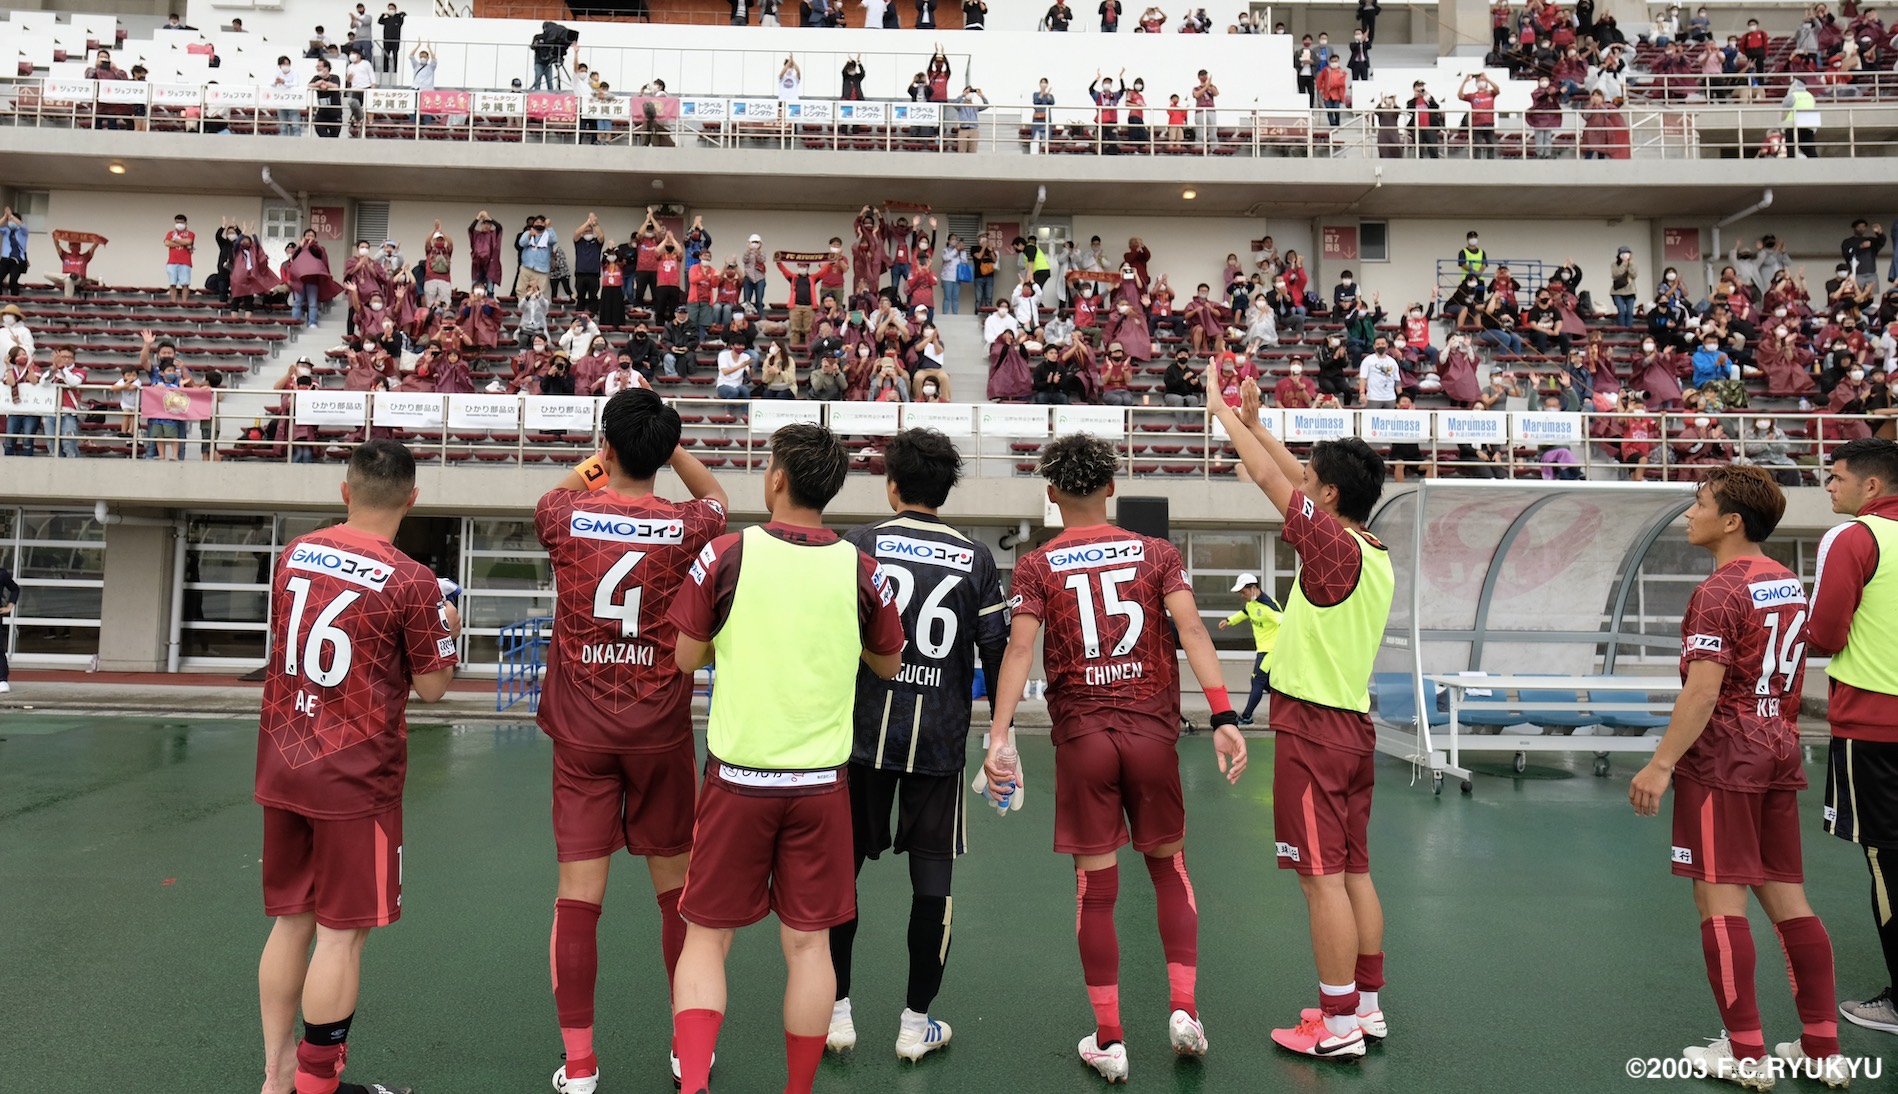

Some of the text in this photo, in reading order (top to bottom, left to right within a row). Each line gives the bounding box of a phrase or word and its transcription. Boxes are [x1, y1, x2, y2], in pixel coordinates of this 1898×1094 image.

[373, 99, 408, 109] 沖縄市
[481, 102, 516, 112] 沖縄市
[588, 105, 623, 114] 沖縄市
[311, 401, 362, 410] ひかり部品店
[390, 403, 440, 412] ひかり部品店
[465, 405, 515, 414] ひかり部品店
[541, 405, 591, 414] ひかり部品店
[1295, 415, 1343, 429] Marumasa
[1371, 416, 1420, 431] Marumasa
[1448, 417, 1497, 431] Marumasa
[1522, 418, 1571, 432] Marumasa
[584, 463, 603, 482] C
[571, 517, 682, 539] GMOコイン
[877, 540, 972, 565] GMOコイン
[1049, 544, 1143, 566] GMOコイン
[291, 549, 389, 583] GMOコイン
[593, 550, 647, 639] 4
[1064, 566, 1145, 660] 15
[285, 576, 362, 688] 16
[1695, 636, 1720, 648] TA
[582, 643, 654, 666] OKAZAKI
[1755, 609, 1807, 696] 14
[1085, 662, 1143, 686] CHINEN
[295, 690, 318, 717] AE
